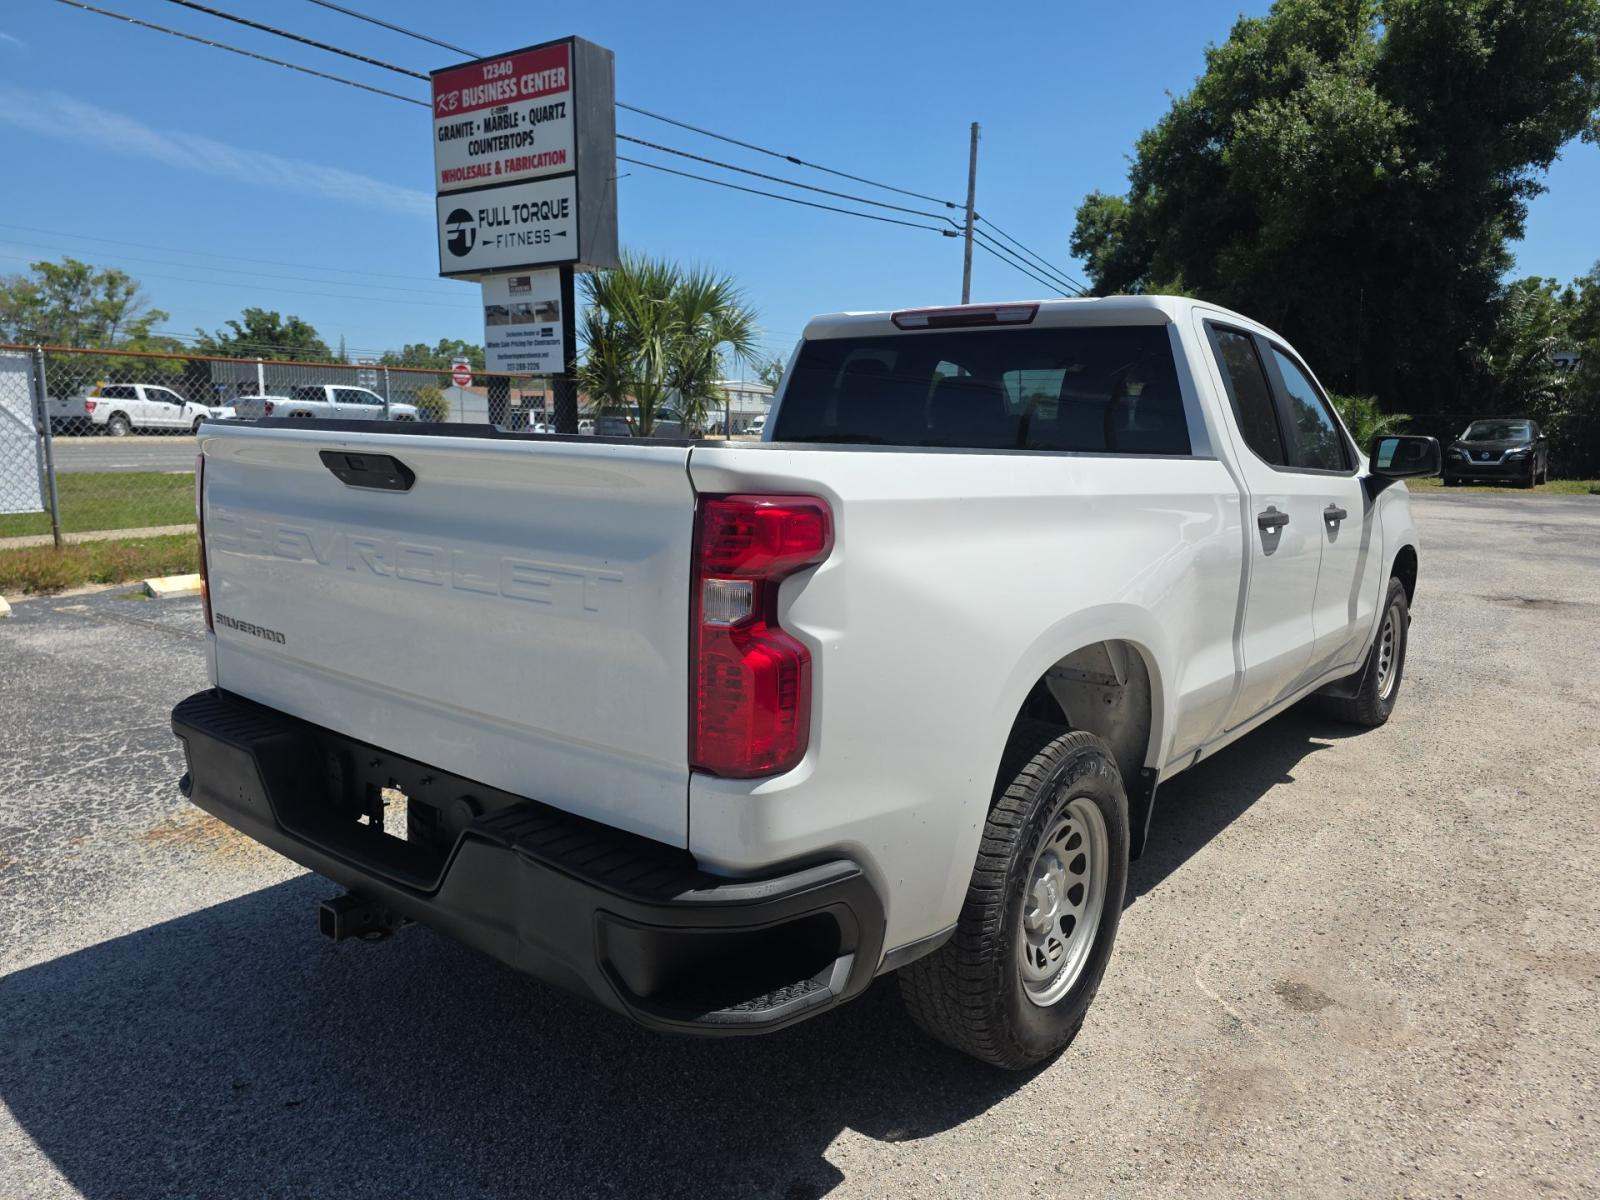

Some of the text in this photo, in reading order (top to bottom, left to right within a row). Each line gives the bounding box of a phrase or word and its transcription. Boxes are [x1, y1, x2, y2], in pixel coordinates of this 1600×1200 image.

[483, 60, 513, 80] 12340
[462, 77, 518, 107] BUSINESS
[521, 67, 566, 95] CENTER
[438, 121, 474, 142] GRANITE
[484, 112, 519, 134] MARBLE
[529, 102, 566, 126] QUARTZ
[468, 130, 535, 156] COUNTERTOPS
[441, 163, 491, 184] WHOLESALE
[505, 149, 566, 174] FABRICATION
[478, 198, 570, 229] FULL TORQUE
[496, 229, 551, 249] FITNESS
[215, 612, 287, 646] SILVERADO
